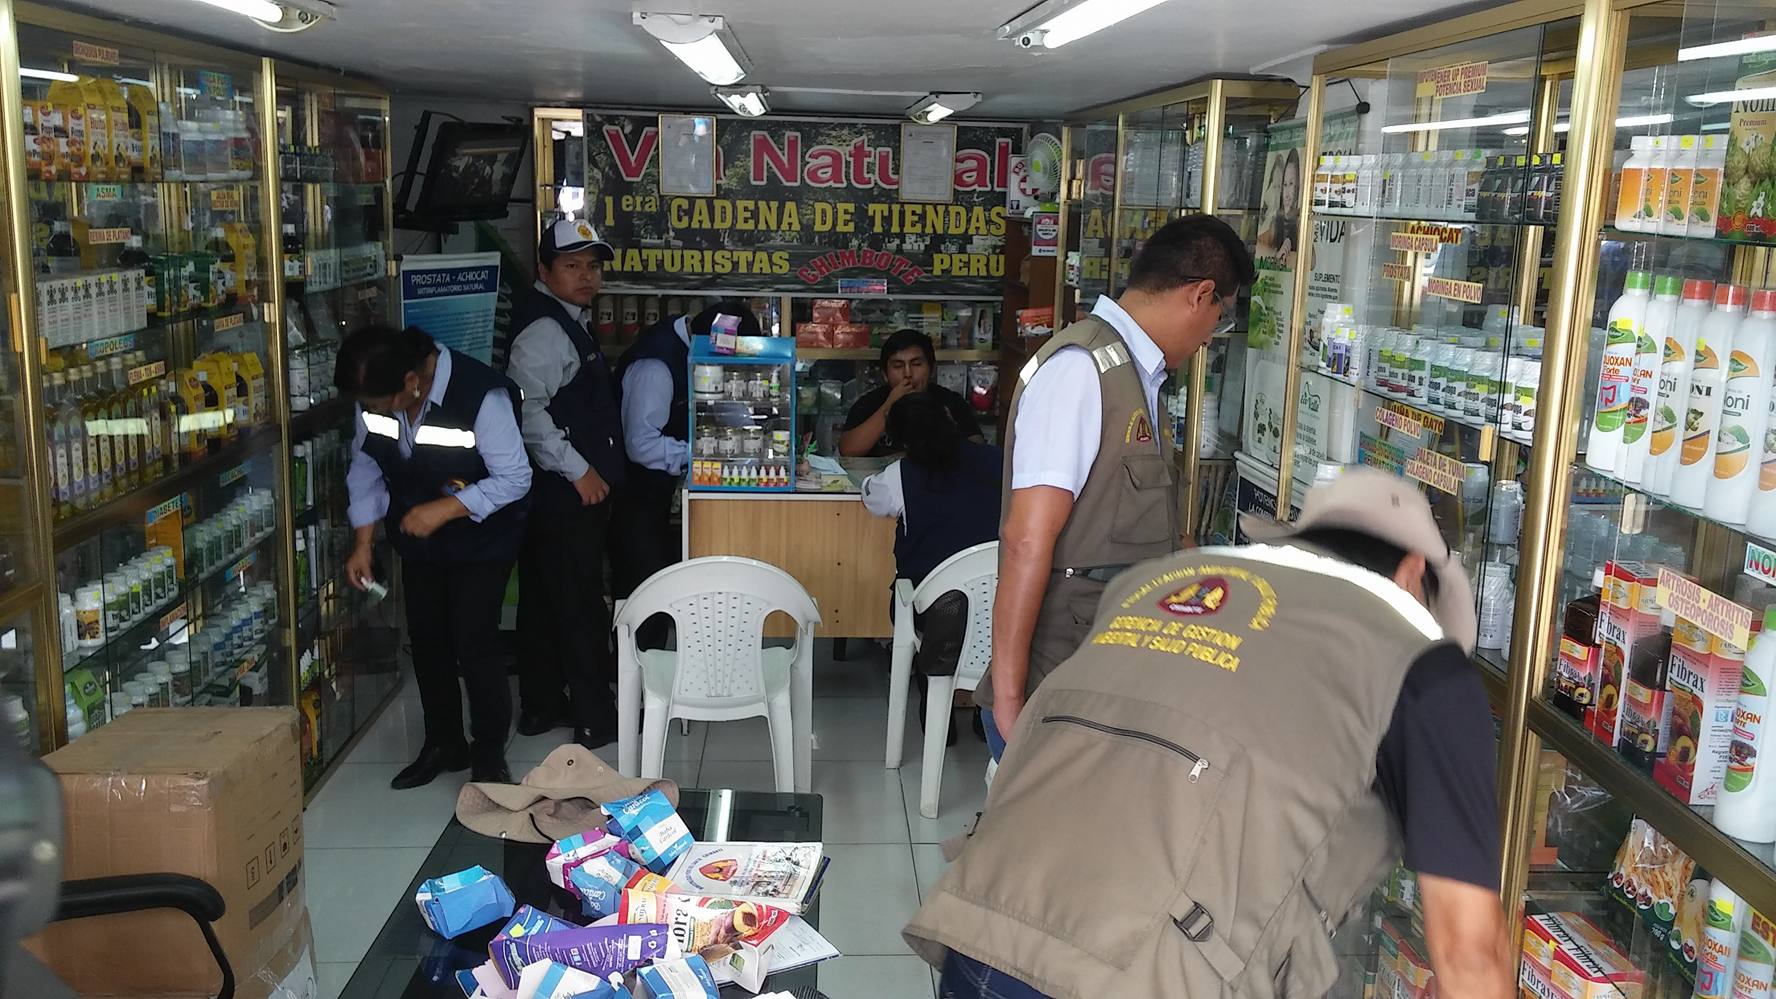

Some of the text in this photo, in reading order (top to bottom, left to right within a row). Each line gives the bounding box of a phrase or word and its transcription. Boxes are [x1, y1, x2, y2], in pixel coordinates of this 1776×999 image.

[1461, 62, 1488, 79] PREMIUM
[1435, 77, 1485, 97] POTENCIA SEXUAL
[1739, 118, 1767, 127] Premium
[670, 198, 801, 231] CADENA
[813, 202, 856, 234] DE
[867, 203, 1006, 236] TIENDAS
[1410, 225, 1461, 244] ACHIOCAT
[411, 273, 451, 285] PROSTATA
[457, 270, 489, 282] ACHIOCAT
[602, 248, 791, 275] NATURISTAS
[796, 247, 926, 286] CHIMBOTE
[932, 253, 1006, 277] PERU
[1428, 279, 1482, 301] MORINGA EN POLVO
[1659, 377, 1677, 393] oni
[1376, 407, 1420, 436] COLAGENO POLVO
[1423, 415, 1444, 433] GATO
[1407, 460, 1457, 493] COLAGENO CAPSULA
[1659, 570, 1750, 628] ARTROSIS ARTRITIS
[1668, 591, 1735, 640] OSTEOPOROSIS
[1184, 642, 1241, 672] PUBLICA
[1670, 653, 1707, 693] Fibrax
